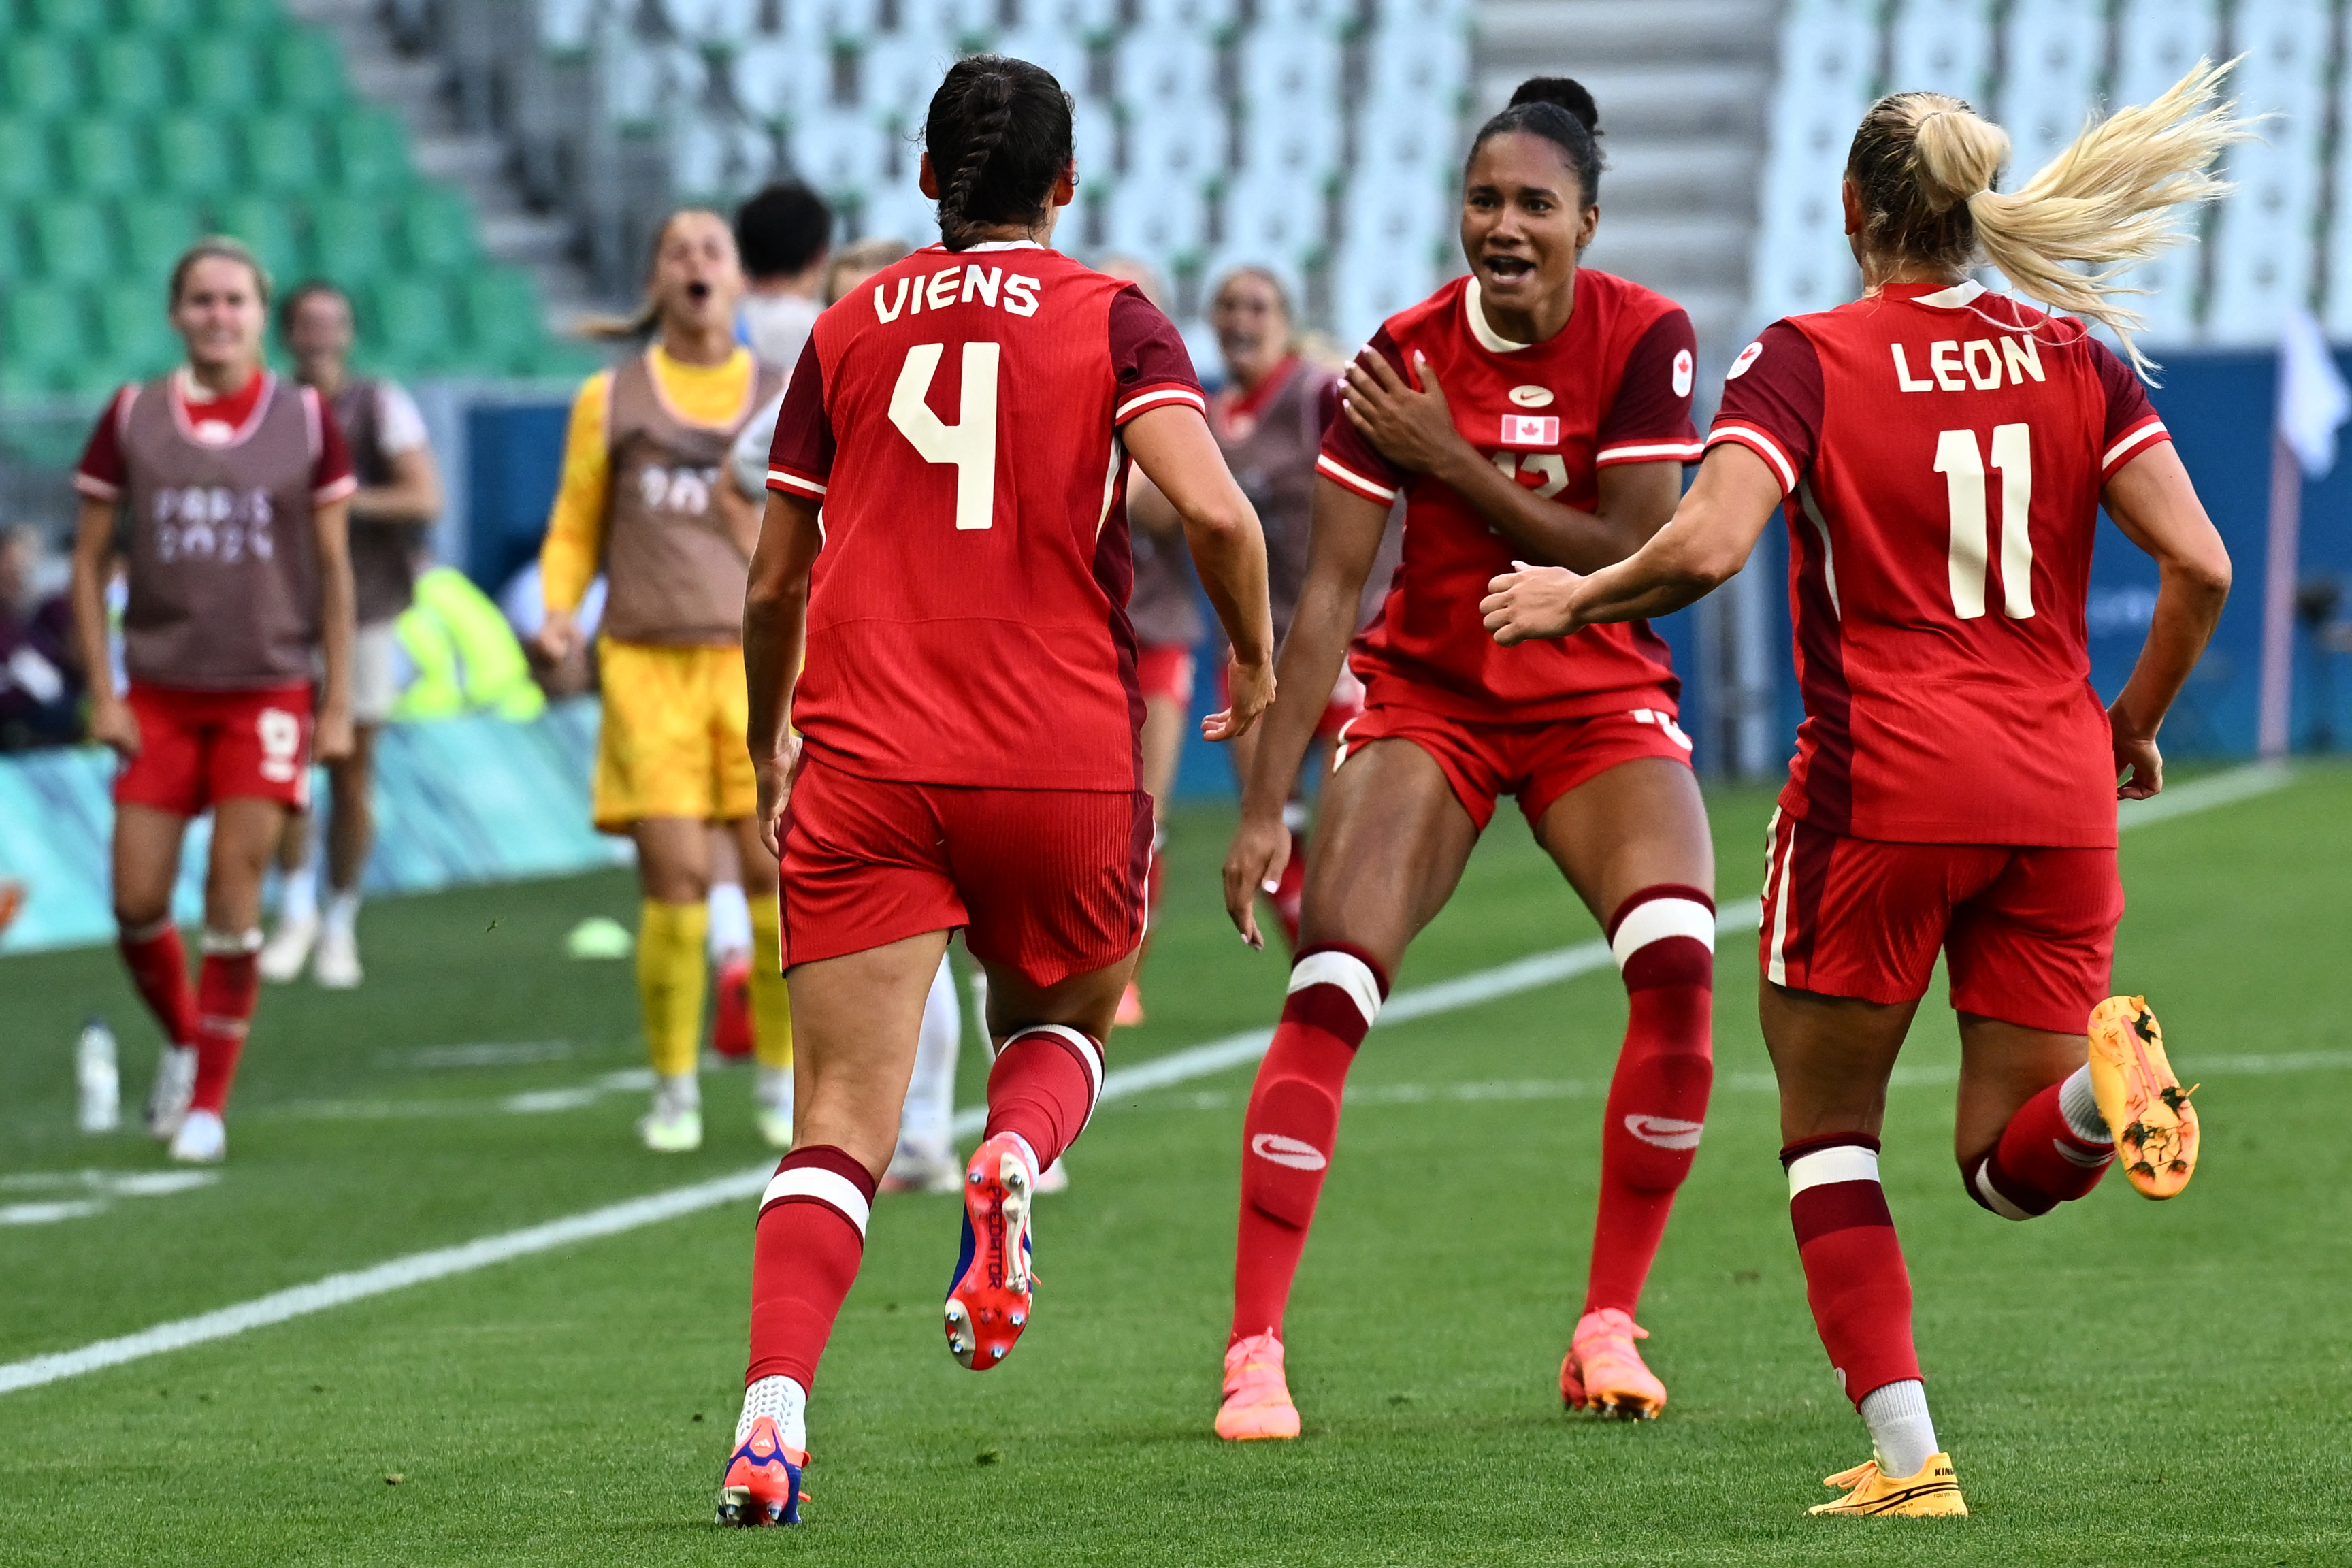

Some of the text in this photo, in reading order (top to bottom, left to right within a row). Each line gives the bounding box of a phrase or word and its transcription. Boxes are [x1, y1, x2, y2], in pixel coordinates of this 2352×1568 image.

[874, 264, 1041, 324] VIENS
[1891, 334, 2046, 393] LEON
[888, 342, 1000, 531] 4
[1492, 451, 1569, 498] 2
[1933, 423, 2036, 619] 11
[987, 1186, 1003, 1289] PREDATOR
